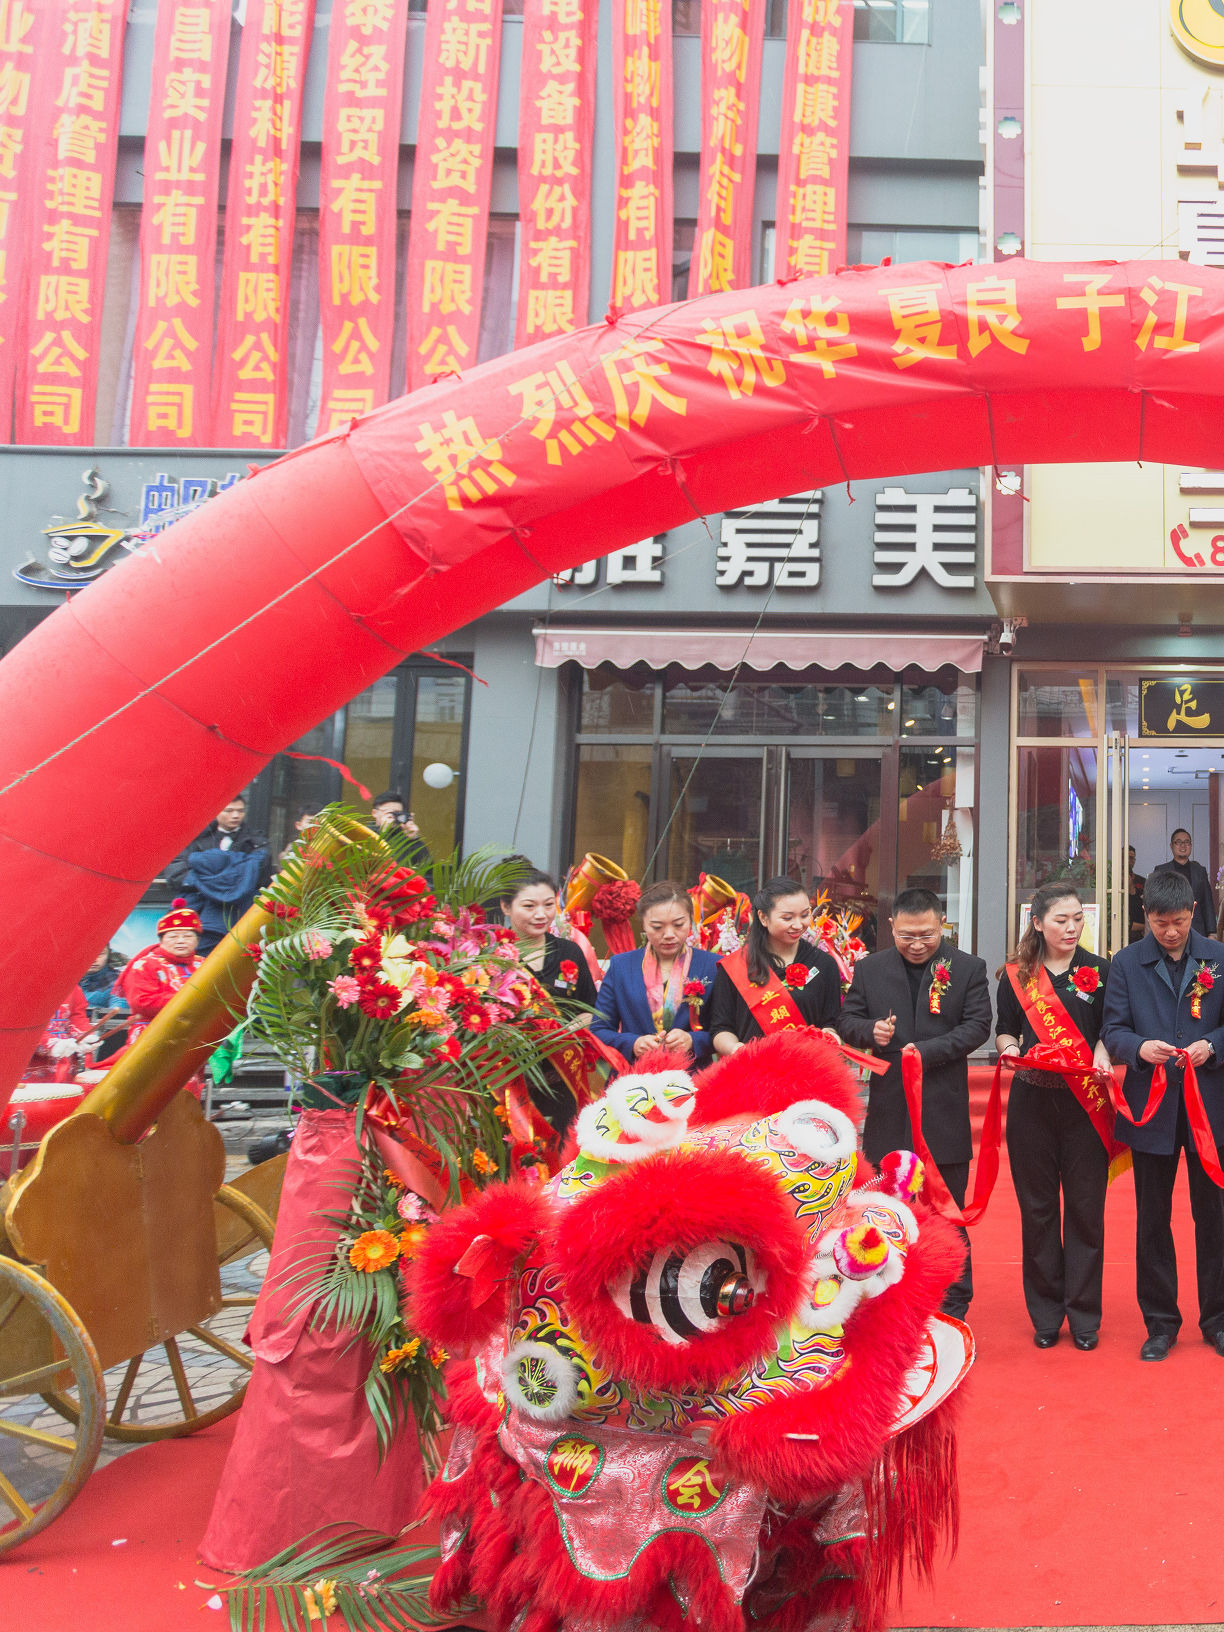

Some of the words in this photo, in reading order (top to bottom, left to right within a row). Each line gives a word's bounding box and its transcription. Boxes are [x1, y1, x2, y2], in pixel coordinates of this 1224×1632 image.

[30, 0, 112, 434] 酒店管理有限公司
[145, 0, 213, 438] 昌实业有限公司
[417, 0, 493, 374] 新投资有限公
[698, 0, 751, 293] 物流有限
[669, 1459, 721, 1510] 会
